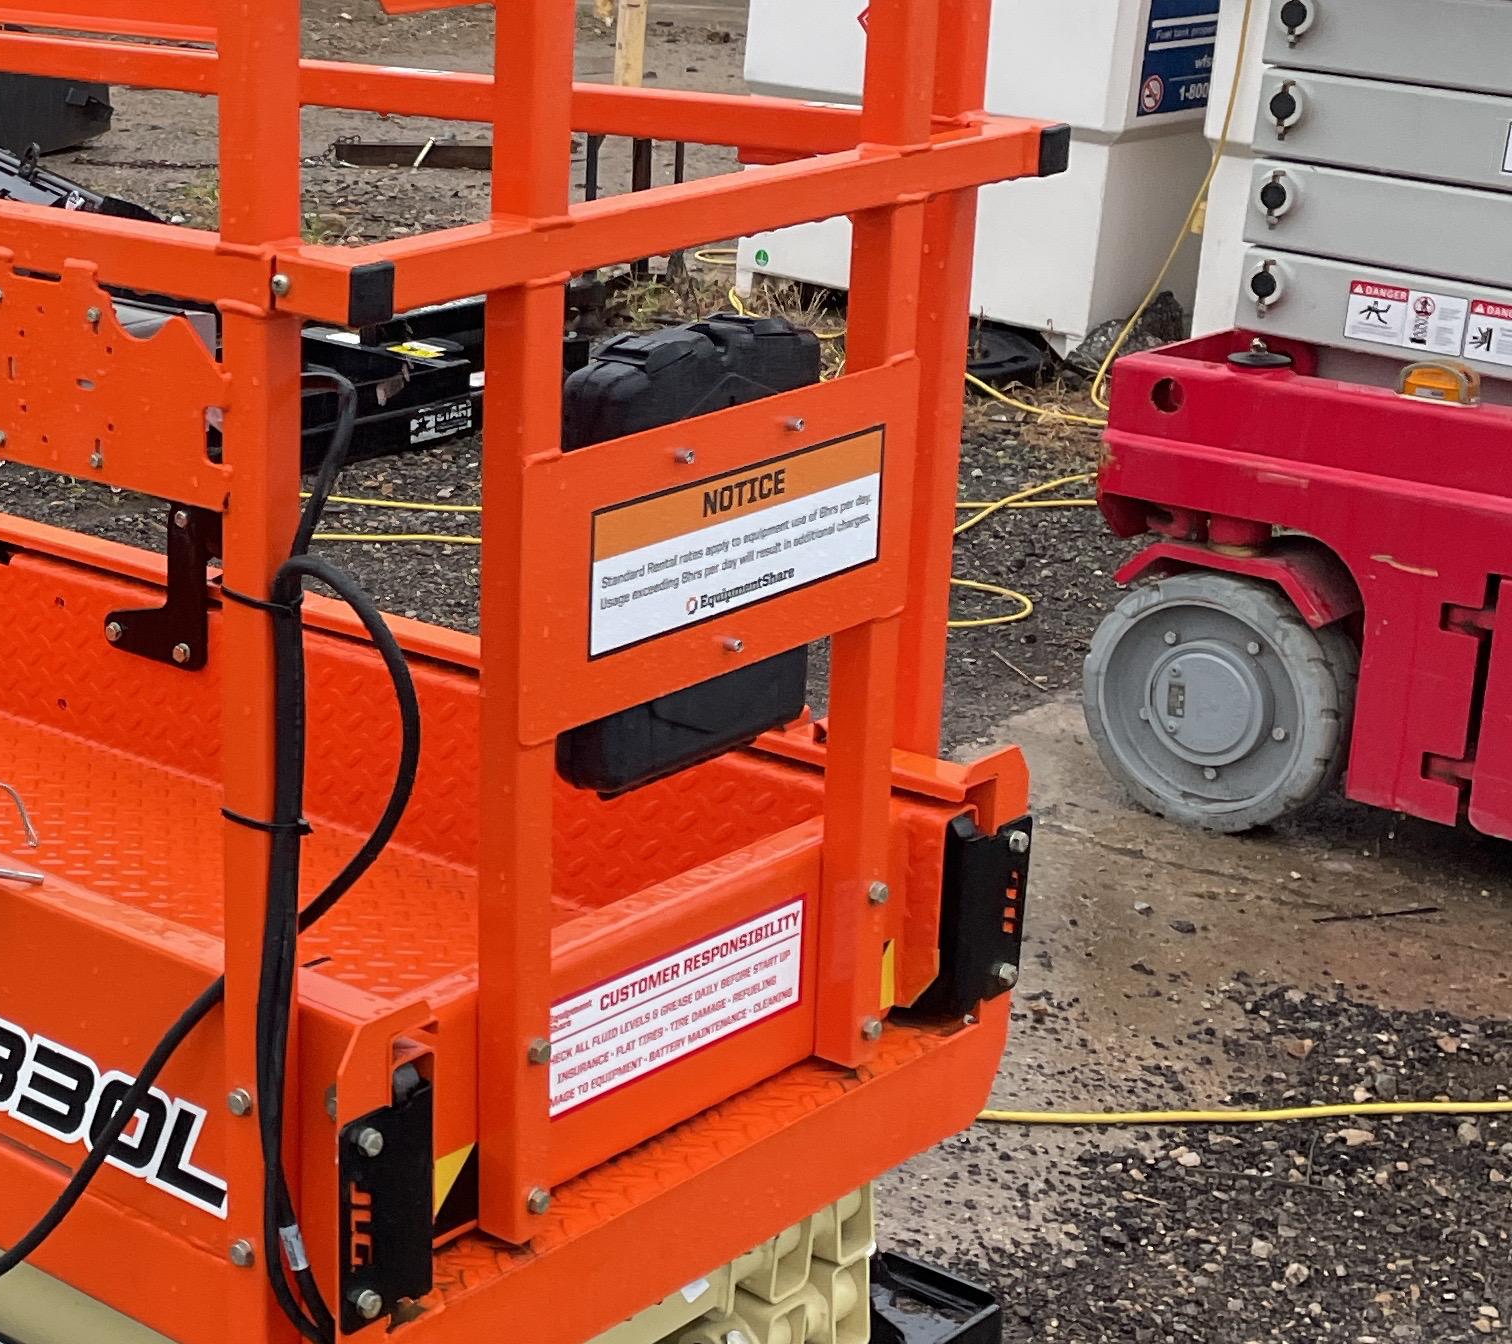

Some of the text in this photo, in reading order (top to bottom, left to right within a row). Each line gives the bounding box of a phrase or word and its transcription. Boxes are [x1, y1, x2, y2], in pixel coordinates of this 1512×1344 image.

[1365, 286, 1407, 301] DANGER
[703, 468, 786, 518] NOTICE
[600, 593, 630, 610] Usage
[632, 577, 680, 600] exceeding
[704, 564, 719, 578] per
[722, 557, 738, 571] day
[739, 550, 755, 565] will
[755, 542, 782, 559] result
[783, 539, 792, 550] in
[793, 523, 836, 547] additional
[601, 565, 645, 589] Standard
[647, 555, 678, 575] Rental
[679, 549, 704, 564] rates
[705, 541, 730, 557] apply
[732, 537, 742, 547] to
[743, 520, 790, 544] equipment
[791, 516, 807, 528] use
[808, 509, 818, 523] of
[840, 500, 854, 514] per
[700, 567, 795, 609] EquipmentShare
[575, 1039, 591, 1055] ALL
[591, 1027, 619, 1047] FLUID
[619, 1012, 651, 1035] LEVELS
[660, 993, 693, 1016] GREASE
[694, 981, 720, 1001] DAILY
[720, 967, 752, 989] BEFORE
[753, 954, 778, 974] START
[779, 949, 791, 963] UP
[600, 962, 680, 1011] CUSTOMER
[683, 910, 800, 975] RESPONSIBILITY
[557, 975, 777, 1084] INSURANCE FLAT TIRES TIRE DAMAGE REFUELING
[577, 1081, 589, 1096] TO
[590, 1056, 643, 1089] EQUIPMENT
[648, 1036, 689, 1063] BATTERY
[688, 1008, 748, 1041] MAINTENANCE
[753, 987, 793, 1014] CLEANING
